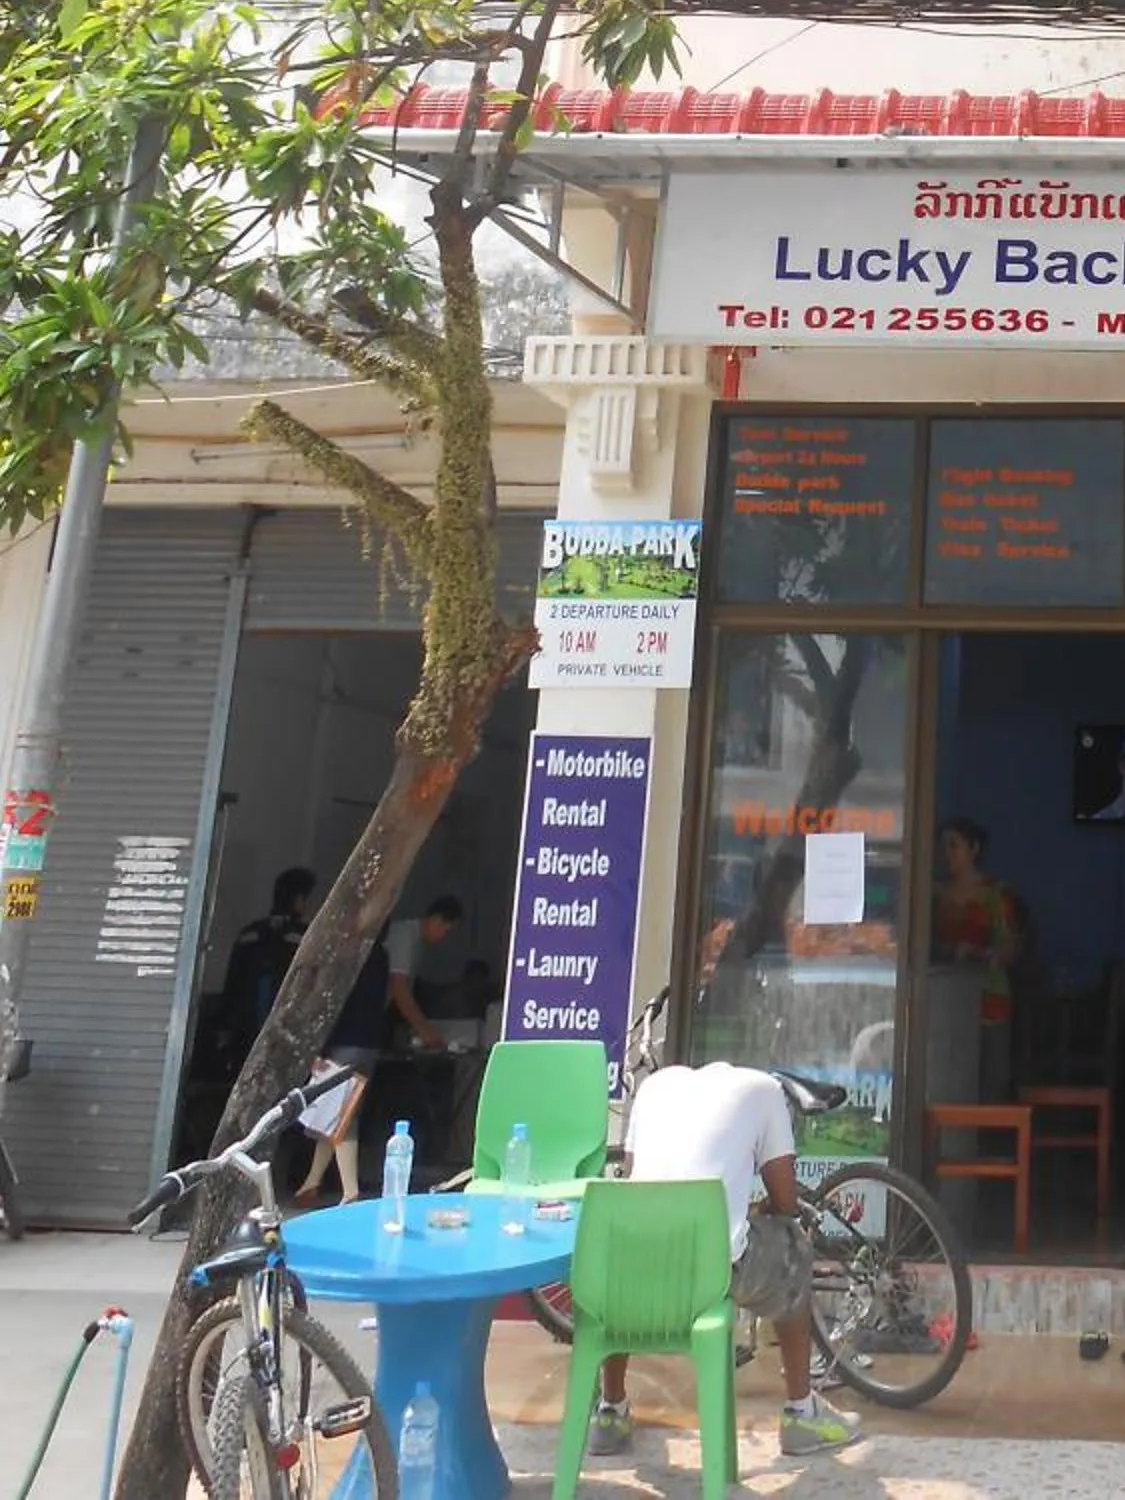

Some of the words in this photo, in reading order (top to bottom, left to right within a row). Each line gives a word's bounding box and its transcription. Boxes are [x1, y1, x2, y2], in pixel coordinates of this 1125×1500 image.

[774, 236, 972, 295] Lucky
[718, 305, 790, 329] Tel:
[804, 306, 875, 330] 021
[887, 307, 1049, 333] 255636
[550, 605, 558, 618] 2
[561, 605, 637, 619] DEPARTURE
[642, 605, 680, 619] DAILY
[559, 631, 573, 653] 10
[575, 631, 597, 653] AM
[637, 631, 645, 653] 2
[647, 631, 668, 653] PM
[557, 663, 607, 676] PRIVATE
[614, 664, 663, 677] VEHICLE
[542, 798, 607, 827] Rental
[532, 897, 598, 927] Rental
[523, 1000, 600, 1031] Service
